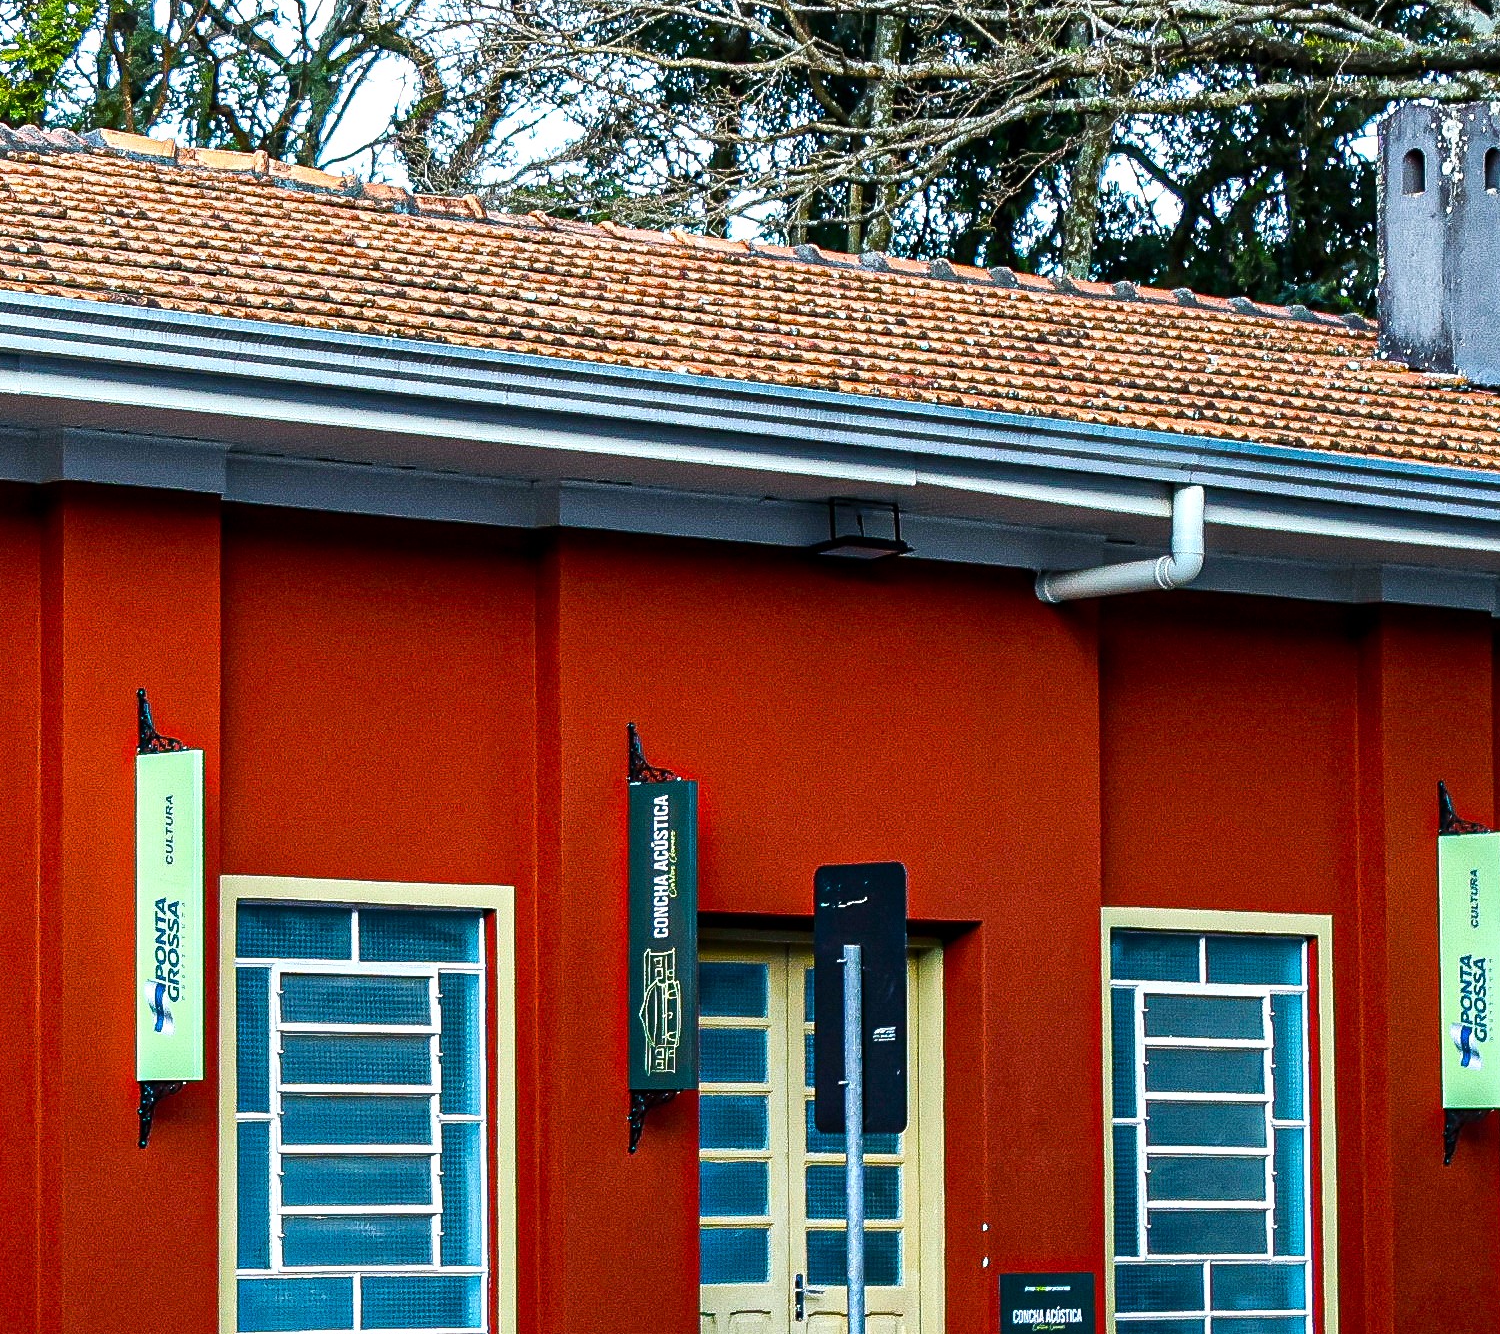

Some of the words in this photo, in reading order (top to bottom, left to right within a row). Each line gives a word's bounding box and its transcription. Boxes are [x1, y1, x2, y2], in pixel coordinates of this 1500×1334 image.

[165, 795, 174, 865] CULTURA
[650, 794, 669, 871] ACÚSTICA
[652, 874, 669, 939] CONCHA
[668, 865, 678, 898] Carlos
[1469, 869, 1479, 928] CULTURA
[154, 896, 167, 981] PONTA
[167, 900, 180, 1003] GROSSA
[1459, 954, 1473, 1025] PONTA
[1473, 957, 1487, 1043] GROSSA
[1012, 1309, 1045, 1324] CONCHA
[1045, 1305, 1083, 1324] ACÚSTICA
